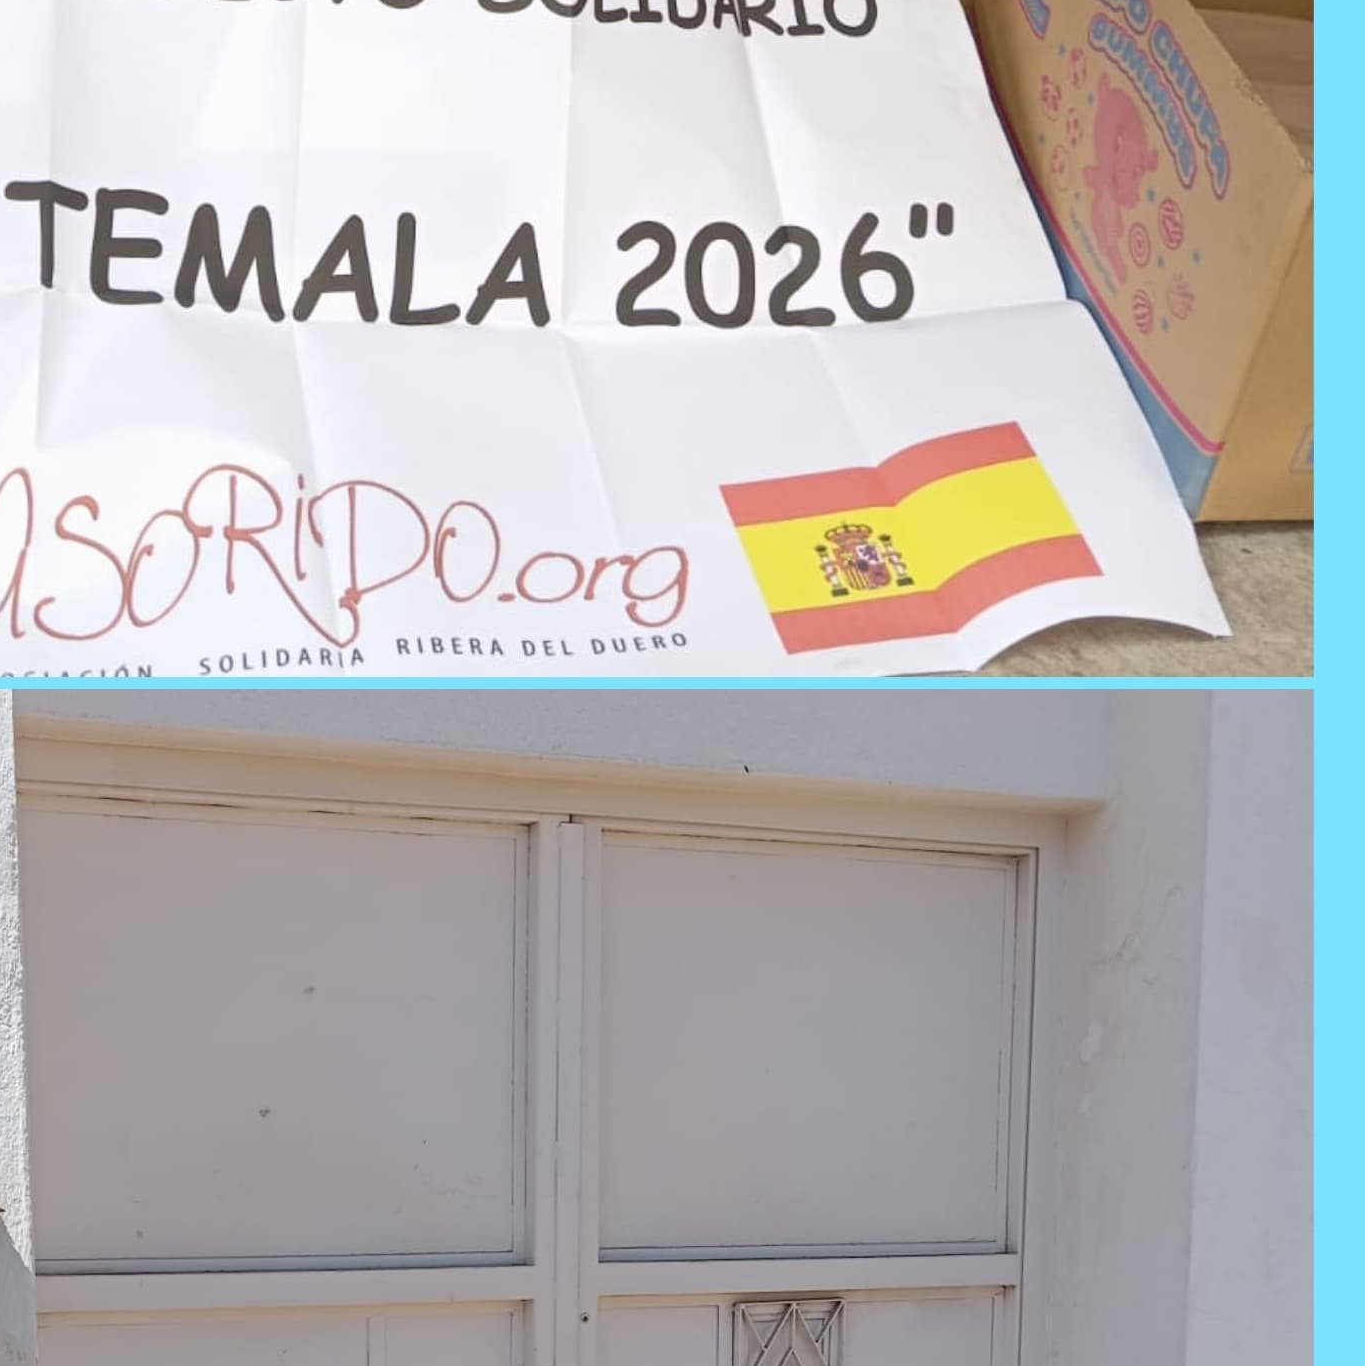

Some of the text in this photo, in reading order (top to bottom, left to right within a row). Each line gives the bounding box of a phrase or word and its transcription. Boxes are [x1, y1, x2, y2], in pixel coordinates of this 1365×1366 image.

[616, 202, 954, 329] 2026"
[199, 632, 687, 676] SOLIDARIA RIBERA DEL DUERO
